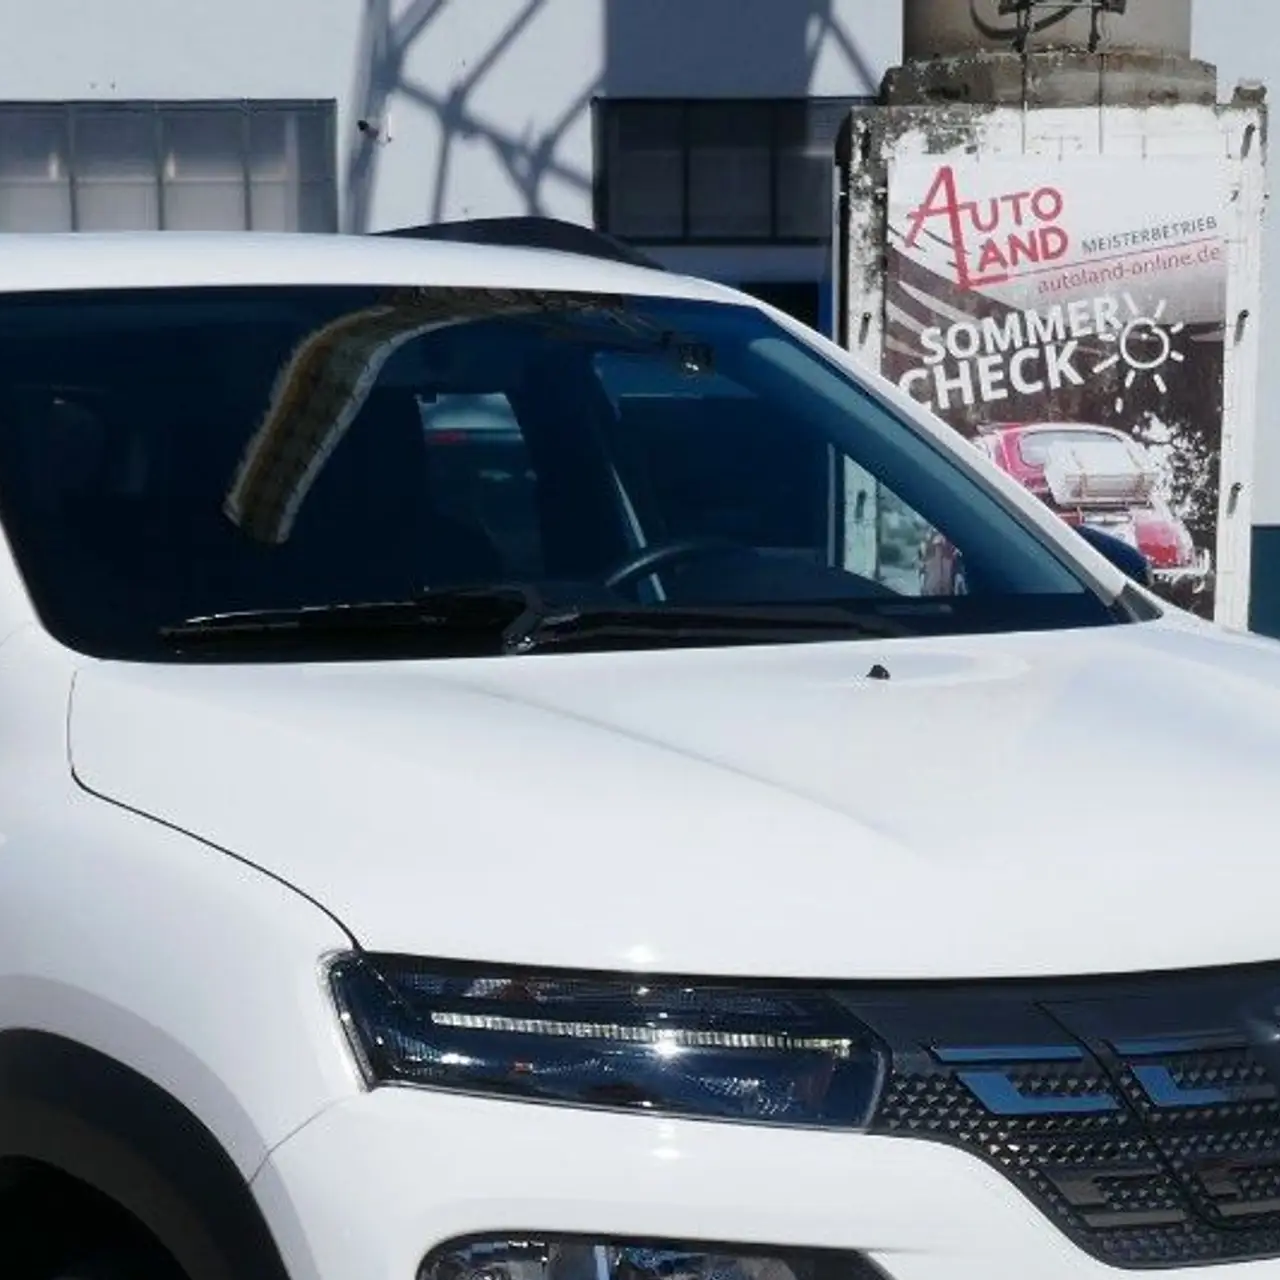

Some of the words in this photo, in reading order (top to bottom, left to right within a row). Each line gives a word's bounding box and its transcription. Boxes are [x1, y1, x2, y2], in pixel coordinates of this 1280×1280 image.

[1081, 215, 1217, 252] MEISTERBETRIEB
[1038, 246, 1221, 294] autoland-online.de
[921, 296, 1123, 365] SOMMER
[899, 340, 1086, 410] CHECK
